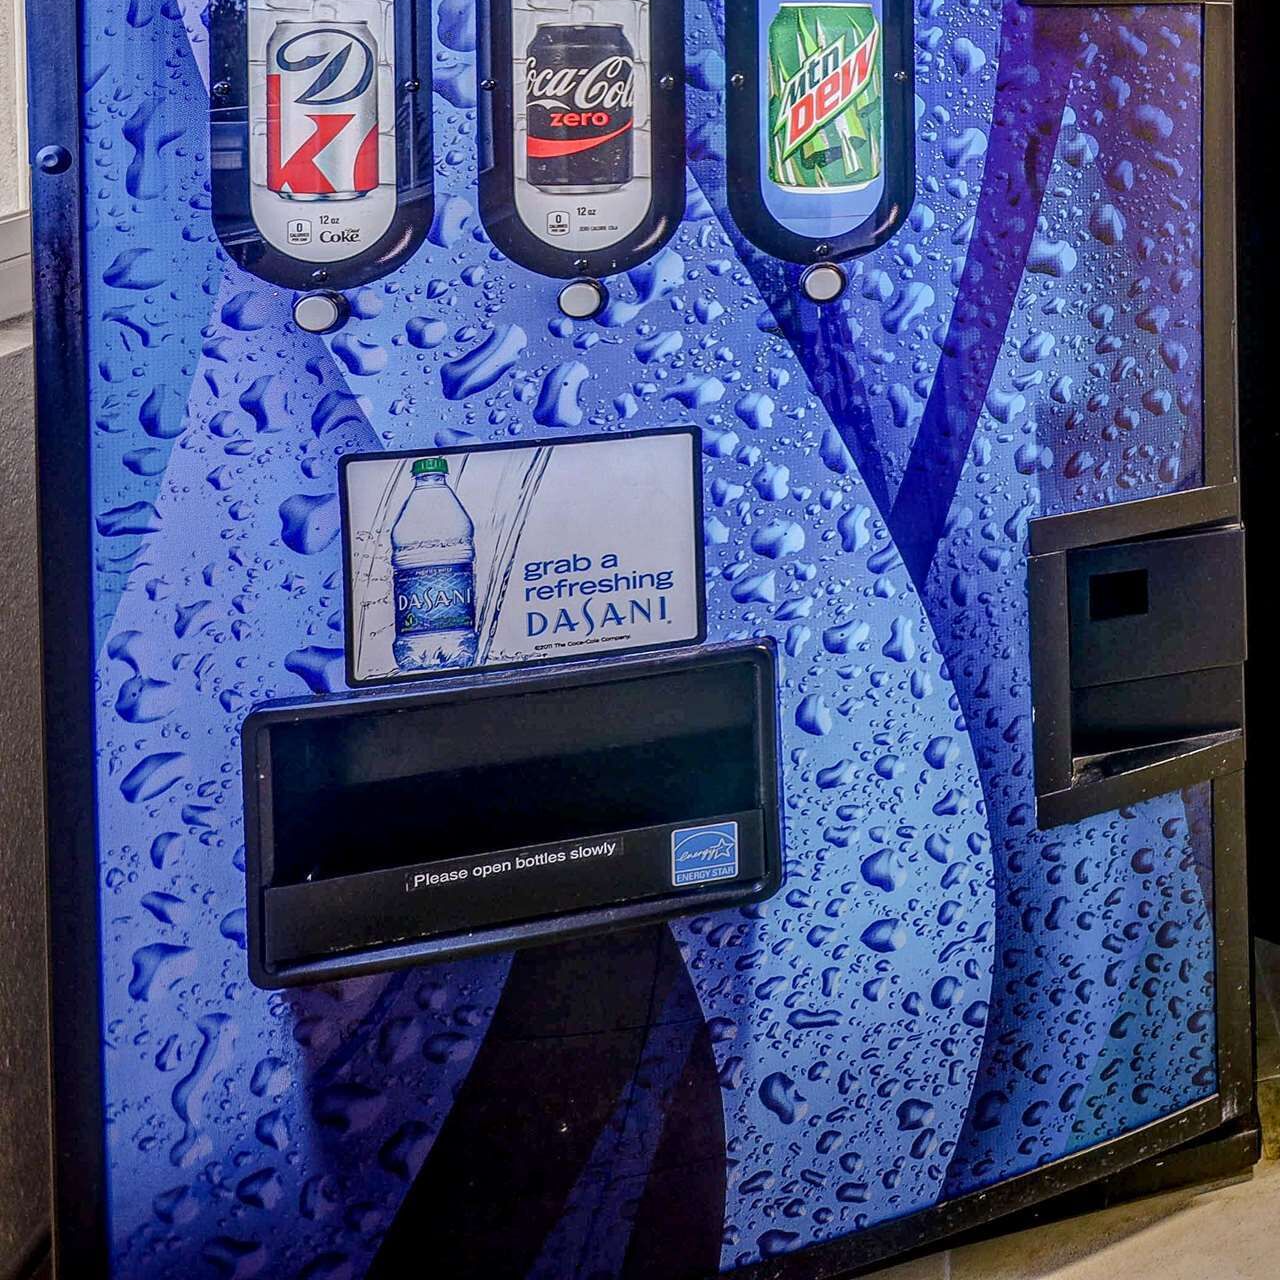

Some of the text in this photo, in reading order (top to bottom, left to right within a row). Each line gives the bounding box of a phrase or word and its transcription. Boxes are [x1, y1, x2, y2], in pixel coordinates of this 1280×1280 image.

[276, 28, 374, 106] D
[550, 111, 610, 128] zero
[320, 215, 340, 225] 12 oz
[555, 214, 562, 224] 0
[576, 207, 587, 216] 12
[296, 222, 303, 233] 0
[319, 230, 361, 243] Coke
[523, 553, 619, 582] grab a
[524, 570, 674, 602] refreshing
[398, 586, 473, 613] DASANI
[526, 596, 667, 637] DASANI
[414, 841, 616, 888] Please open bottles slowly
[676, 865, 734, 883] ENERGY STAR
